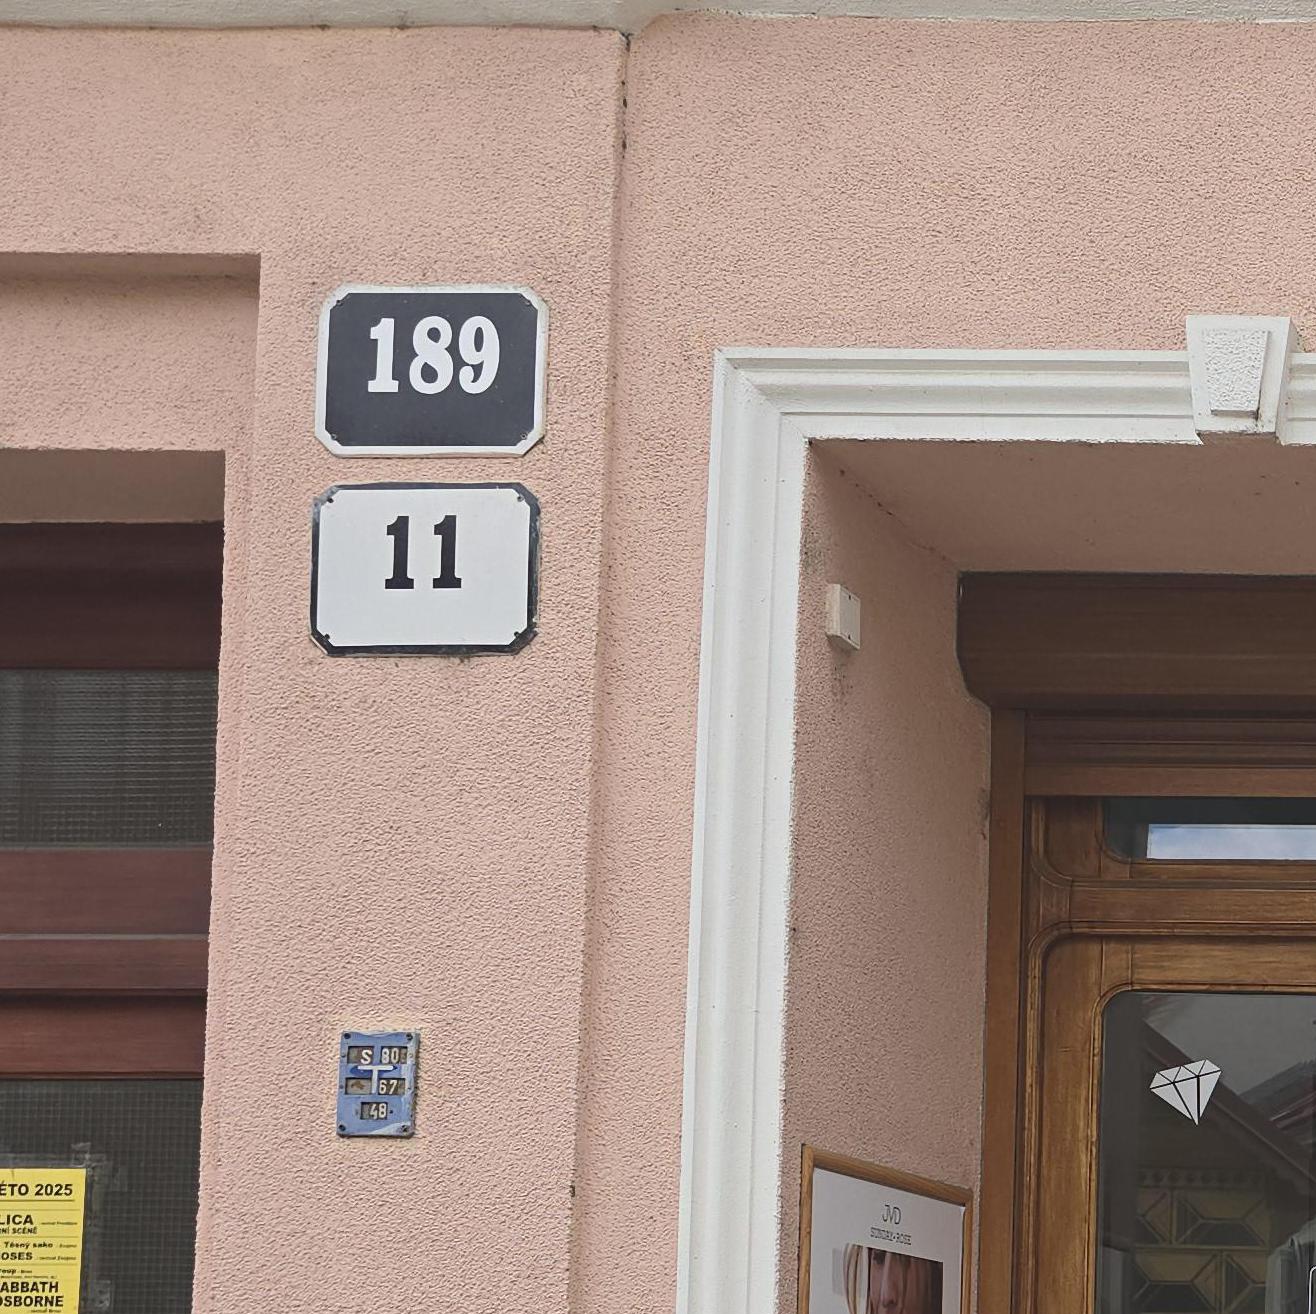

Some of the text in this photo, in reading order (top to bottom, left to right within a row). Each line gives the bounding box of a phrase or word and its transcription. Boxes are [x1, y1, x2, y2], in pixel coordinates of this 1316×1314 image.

[367, 315, 500, 395] 189
[384, 514, 462, 590] 11
[360, 1047, 399, 1064] S 80
[379, 1079, 398, 1095] 67
[369, 1102, 388, 1119] 48
[34, 1183, 73, 1196] 2025
[0, 1281, 59, 1293] ABBATH
